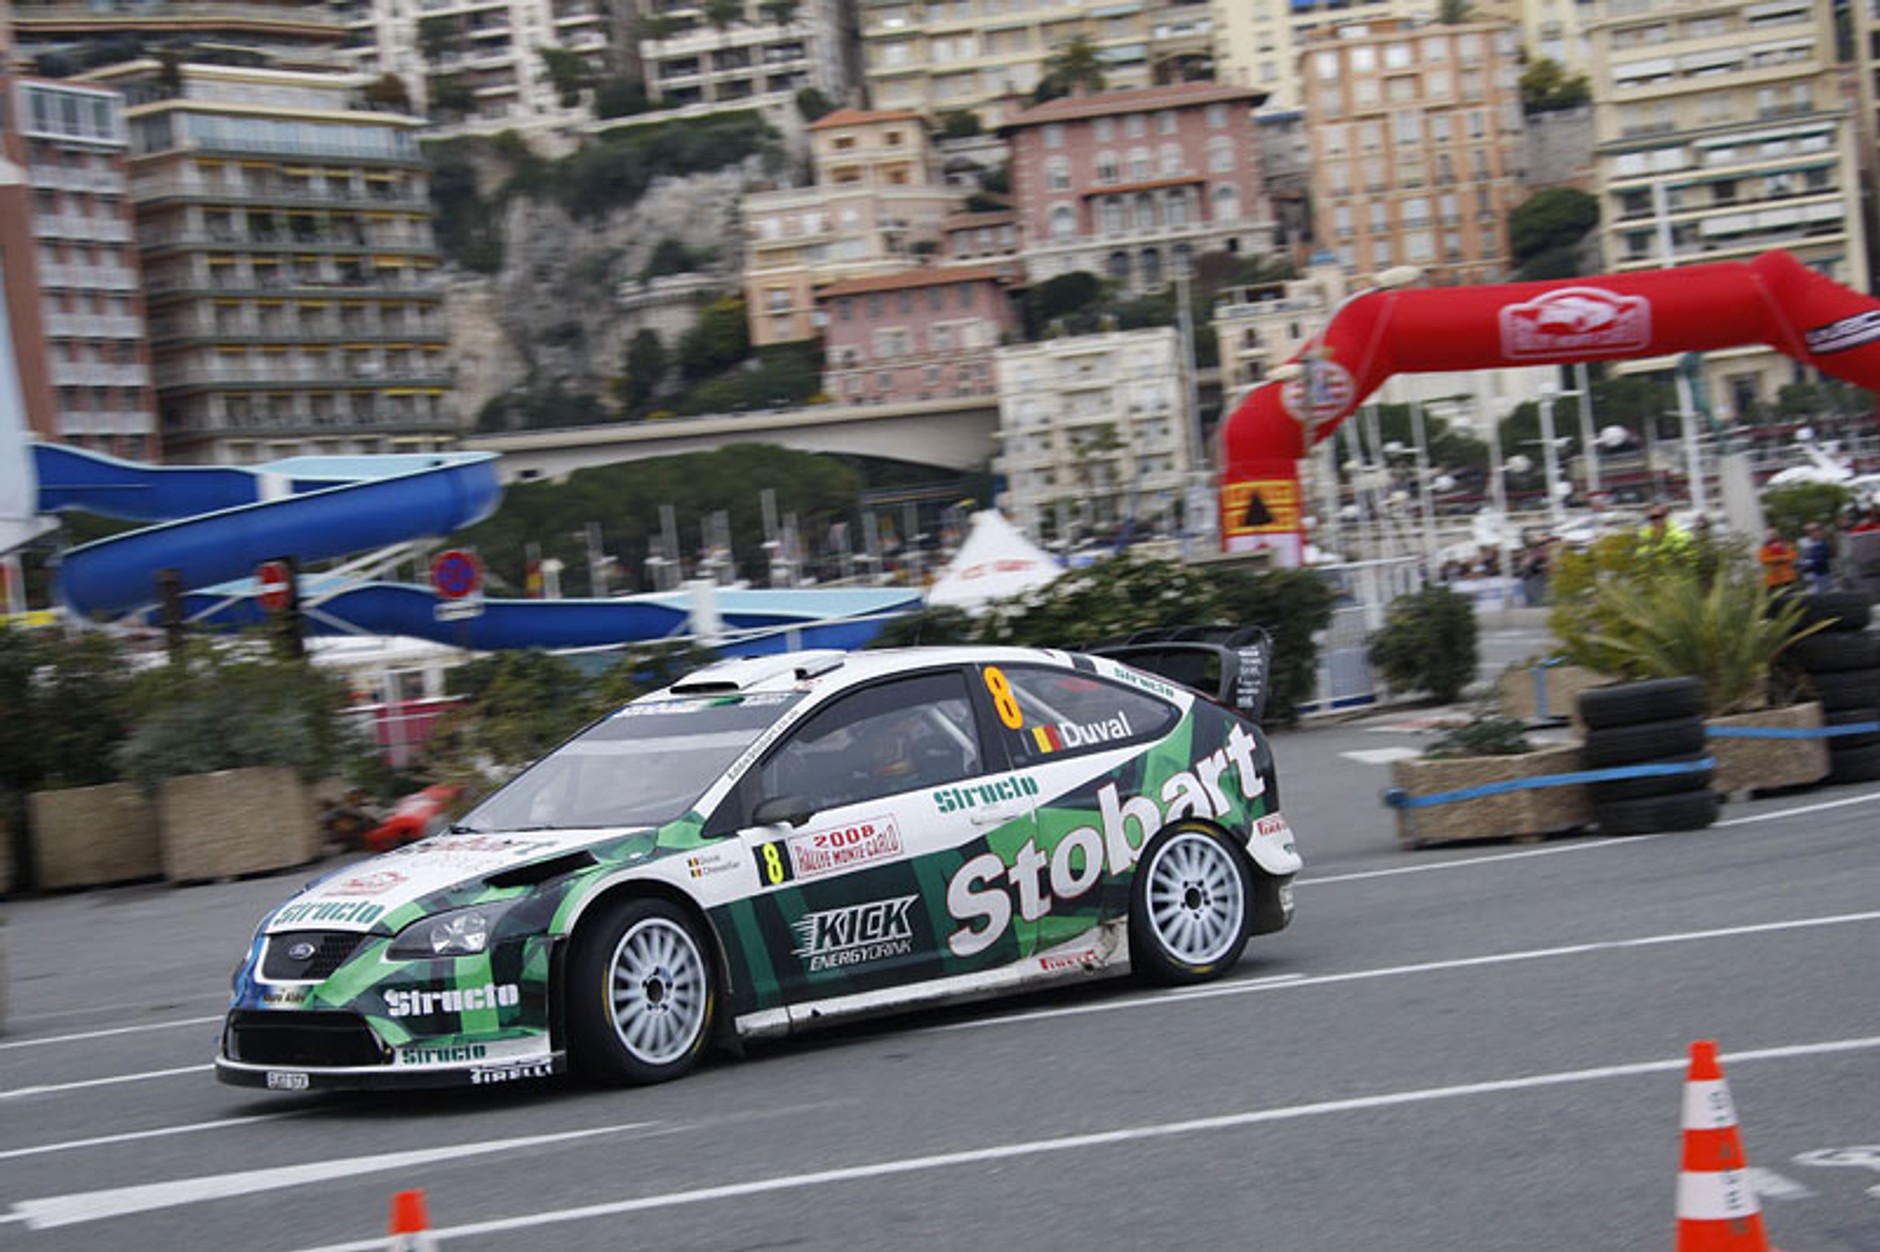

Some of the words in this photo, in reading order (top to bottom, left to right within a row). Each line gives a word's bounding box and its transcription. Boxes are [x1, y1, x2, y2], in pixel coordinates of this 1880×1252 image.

[984, 666, 1024, 730] 8
[1059, 711, 1133, 747] Duval
[933, 776, 1039, 813] Structo
[813, 825, 875, 848] 2008
[947, 722, 1266, 958] Stobart
[762, 842, 784, 884] 8
[804, 894, 919, 957] KICK
[383, 982, 519, 1017] Structo
[401, 1045, 486, 1065] Structo
